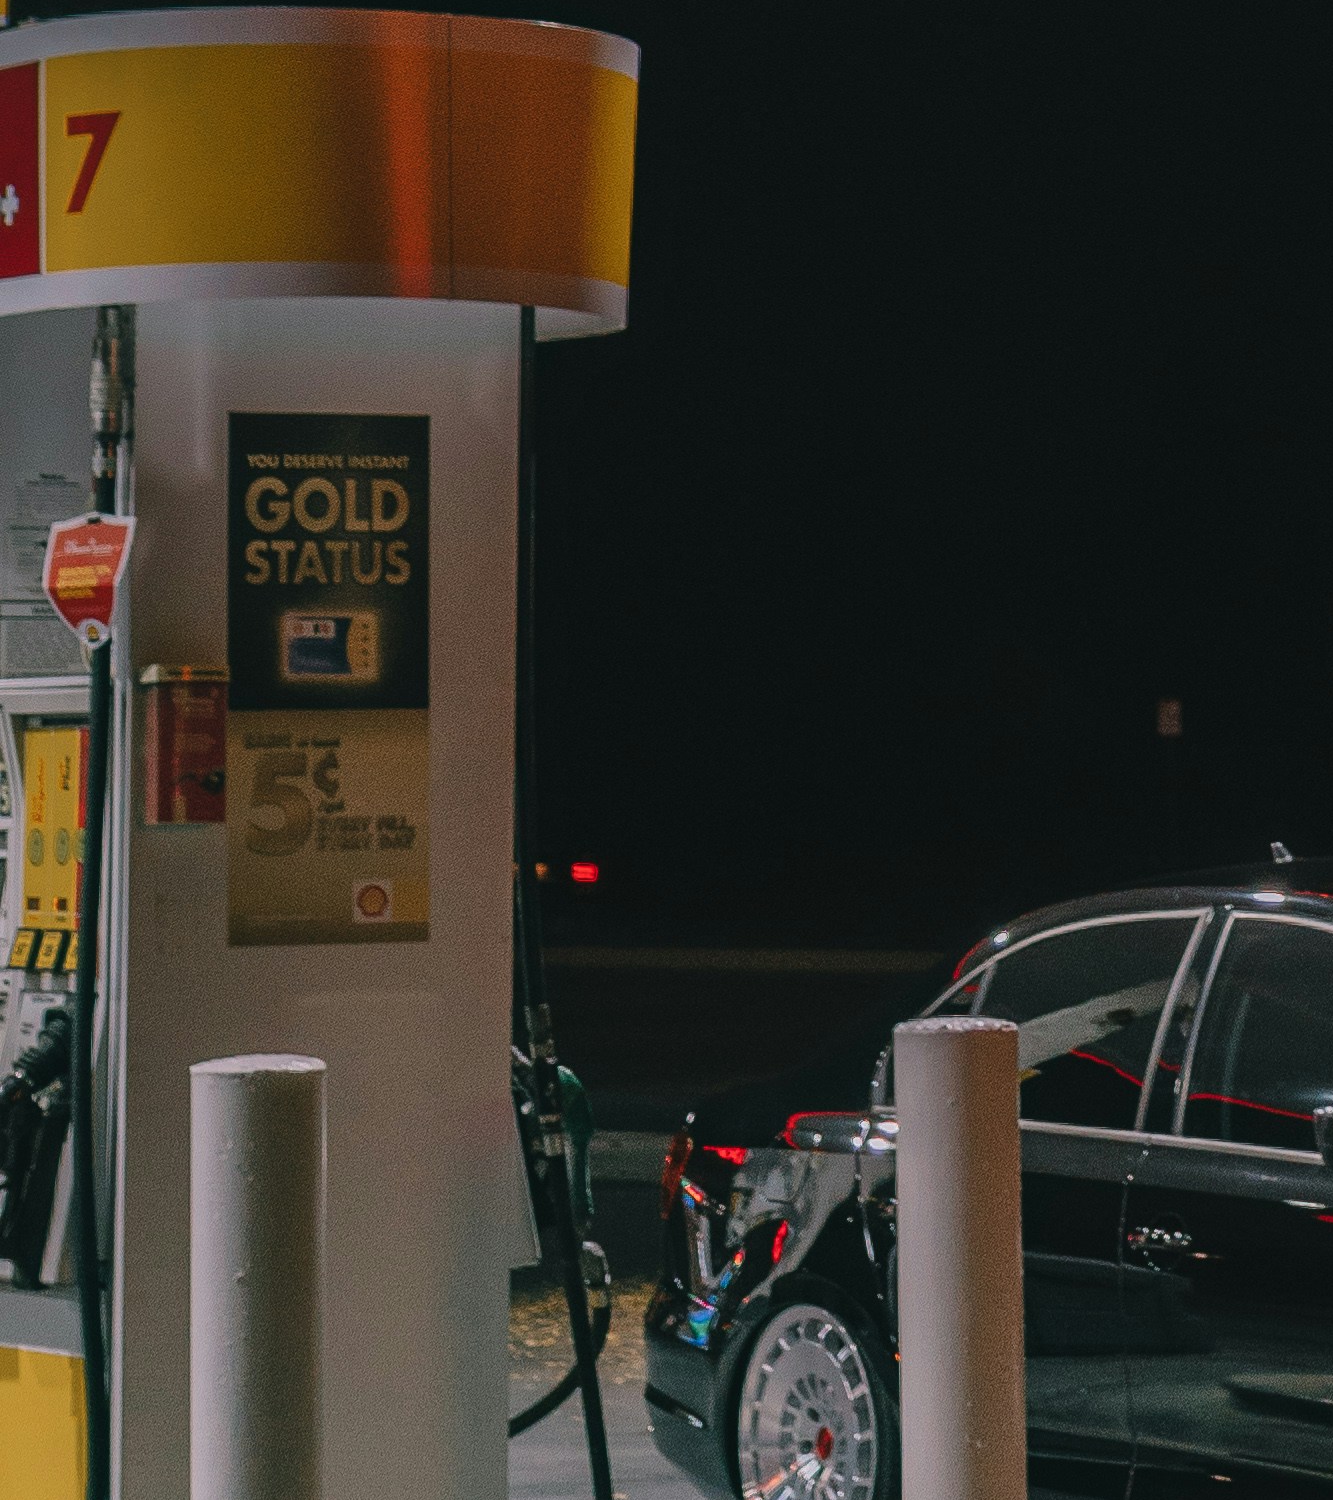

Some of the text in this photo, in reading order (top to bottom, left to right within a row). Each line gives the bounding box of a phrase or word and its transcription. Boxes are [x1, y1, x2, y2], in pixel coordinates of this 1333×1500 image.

[65, 110, 121, 214] 7
[246, 454, 409, 469] YOU DESERVE INSTANT
[244, 476, 411, 533] GOLD
[244, 540, 411, 585] STATUS
